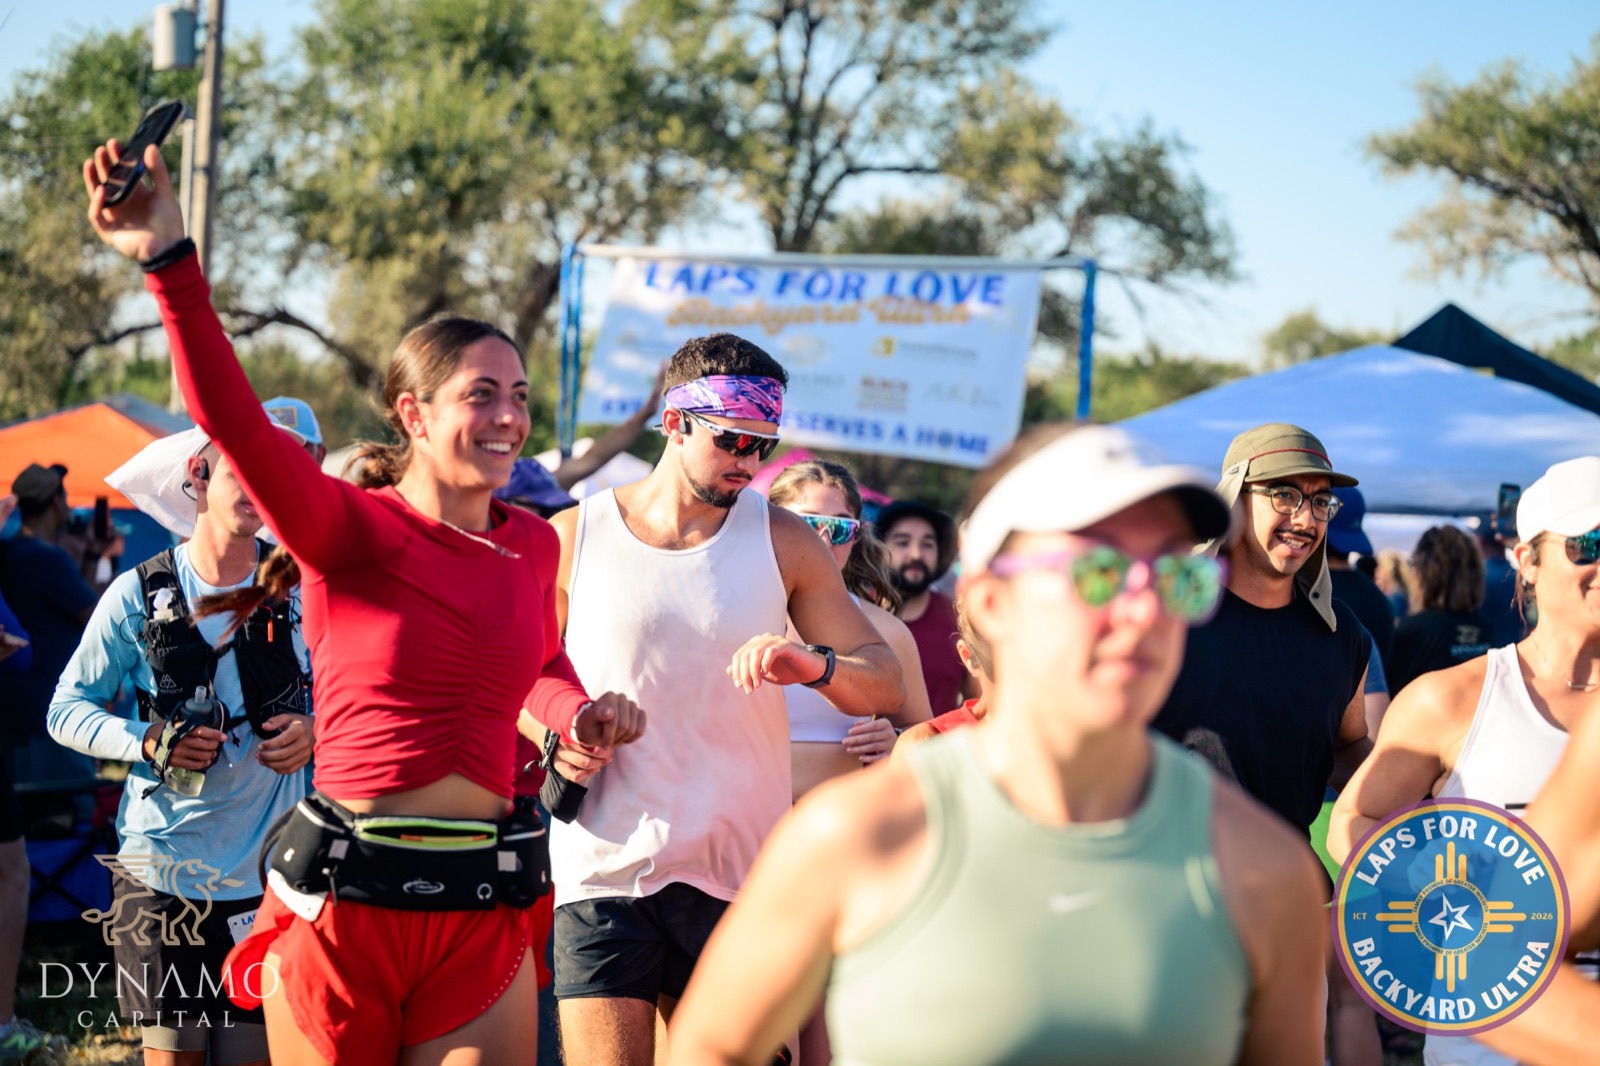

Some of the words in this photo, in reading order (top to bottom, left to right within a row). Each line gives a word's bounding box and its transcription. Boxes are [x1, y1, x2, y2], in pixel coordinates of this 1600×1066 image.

[645, 261, 760, 295] LAPS
[775, 268, 866, 302] FOR
[884, 269, 1005, 306] LOVE
[780, 409, 884, 439] ESERVES
[241, 913, 256, 926] LA
